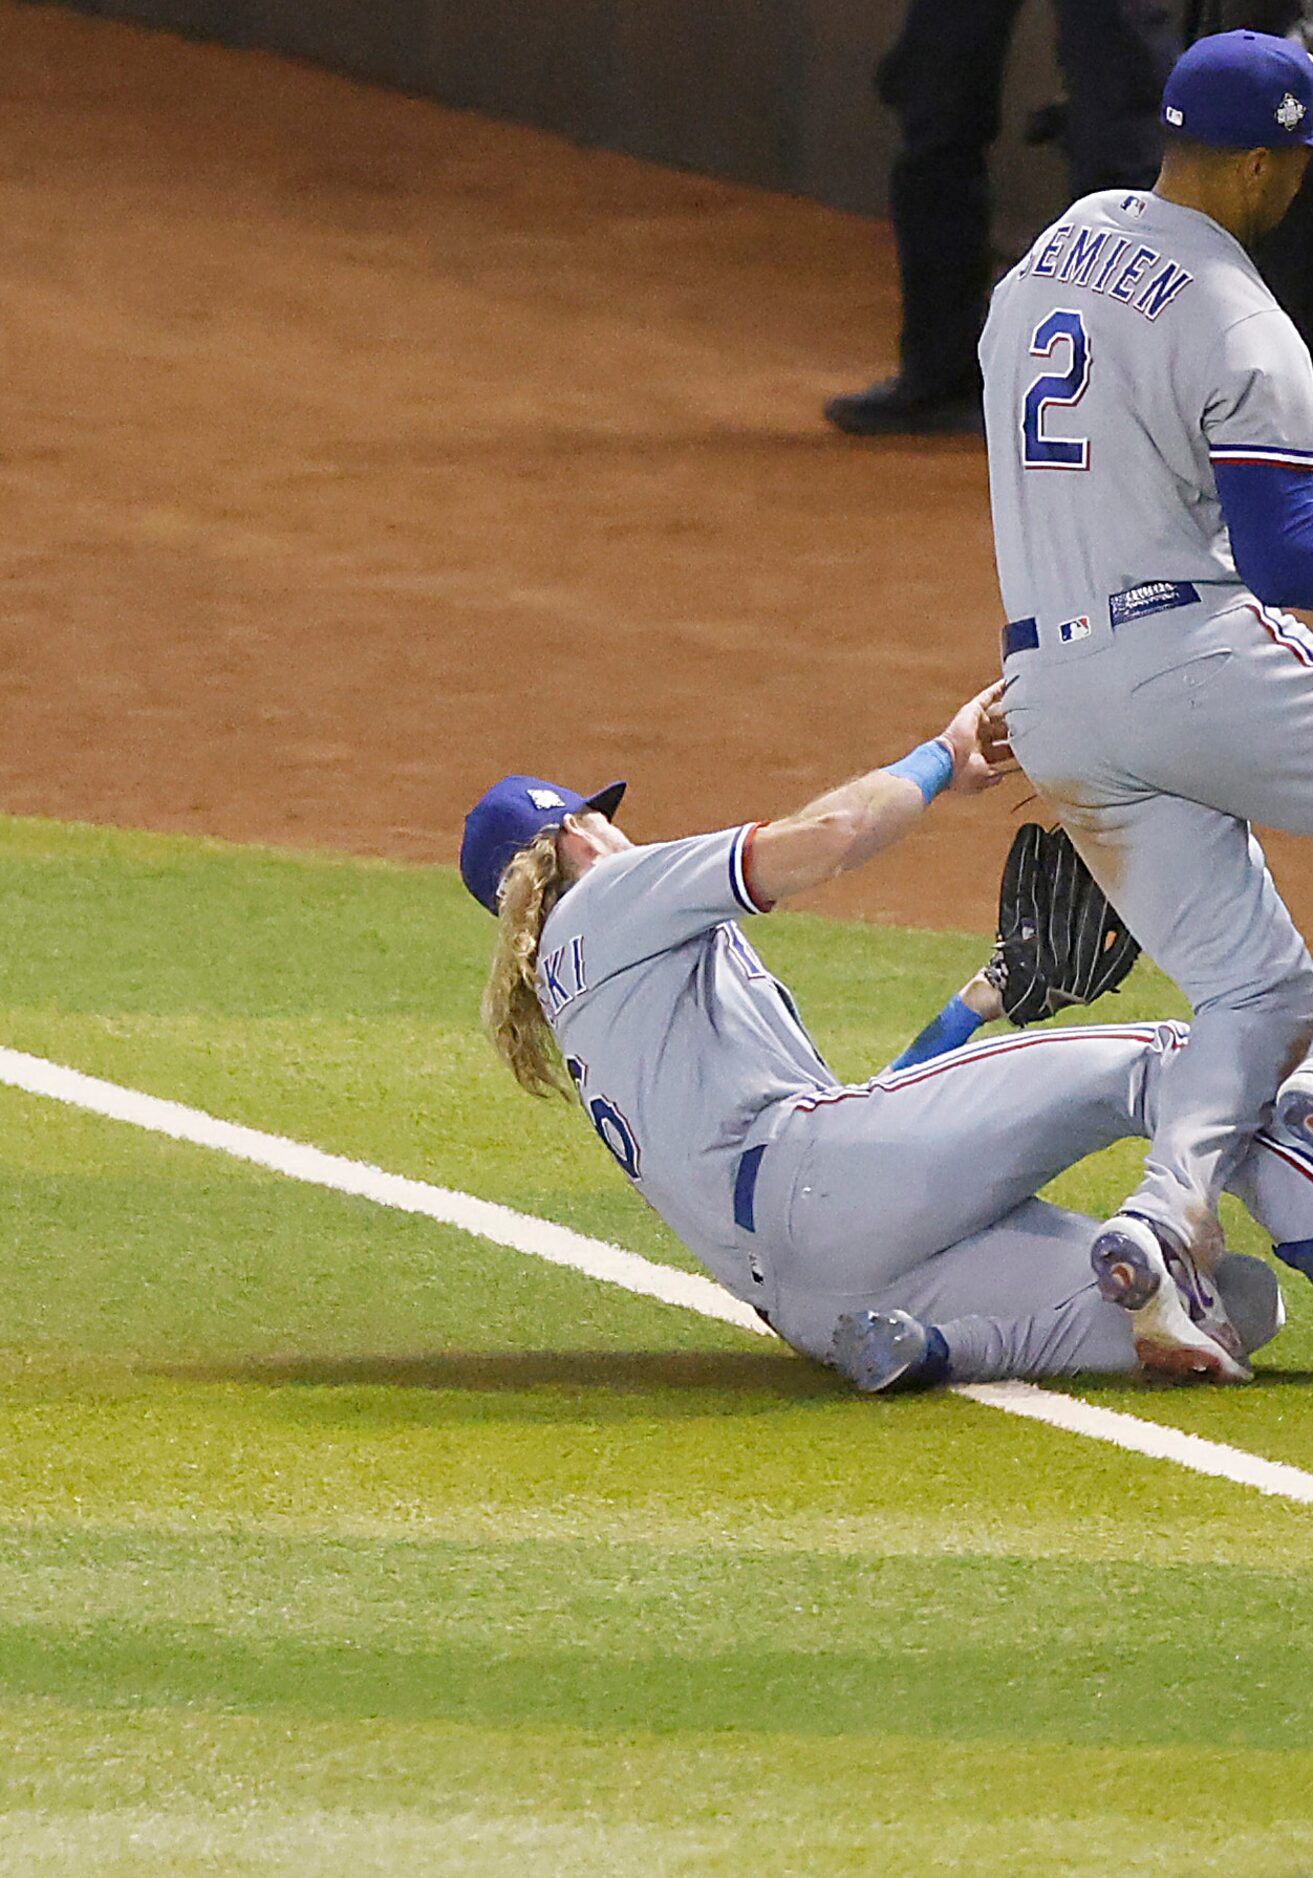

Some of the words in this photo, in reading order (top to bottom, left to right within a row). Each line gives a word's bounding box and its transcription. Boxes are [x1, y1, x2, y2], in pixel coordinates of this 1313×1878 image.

[1018, 222, 1194, 323] EMIEN
[1021, 307, 1092, 471] 2
[540, 934, 588, 1030] KI
